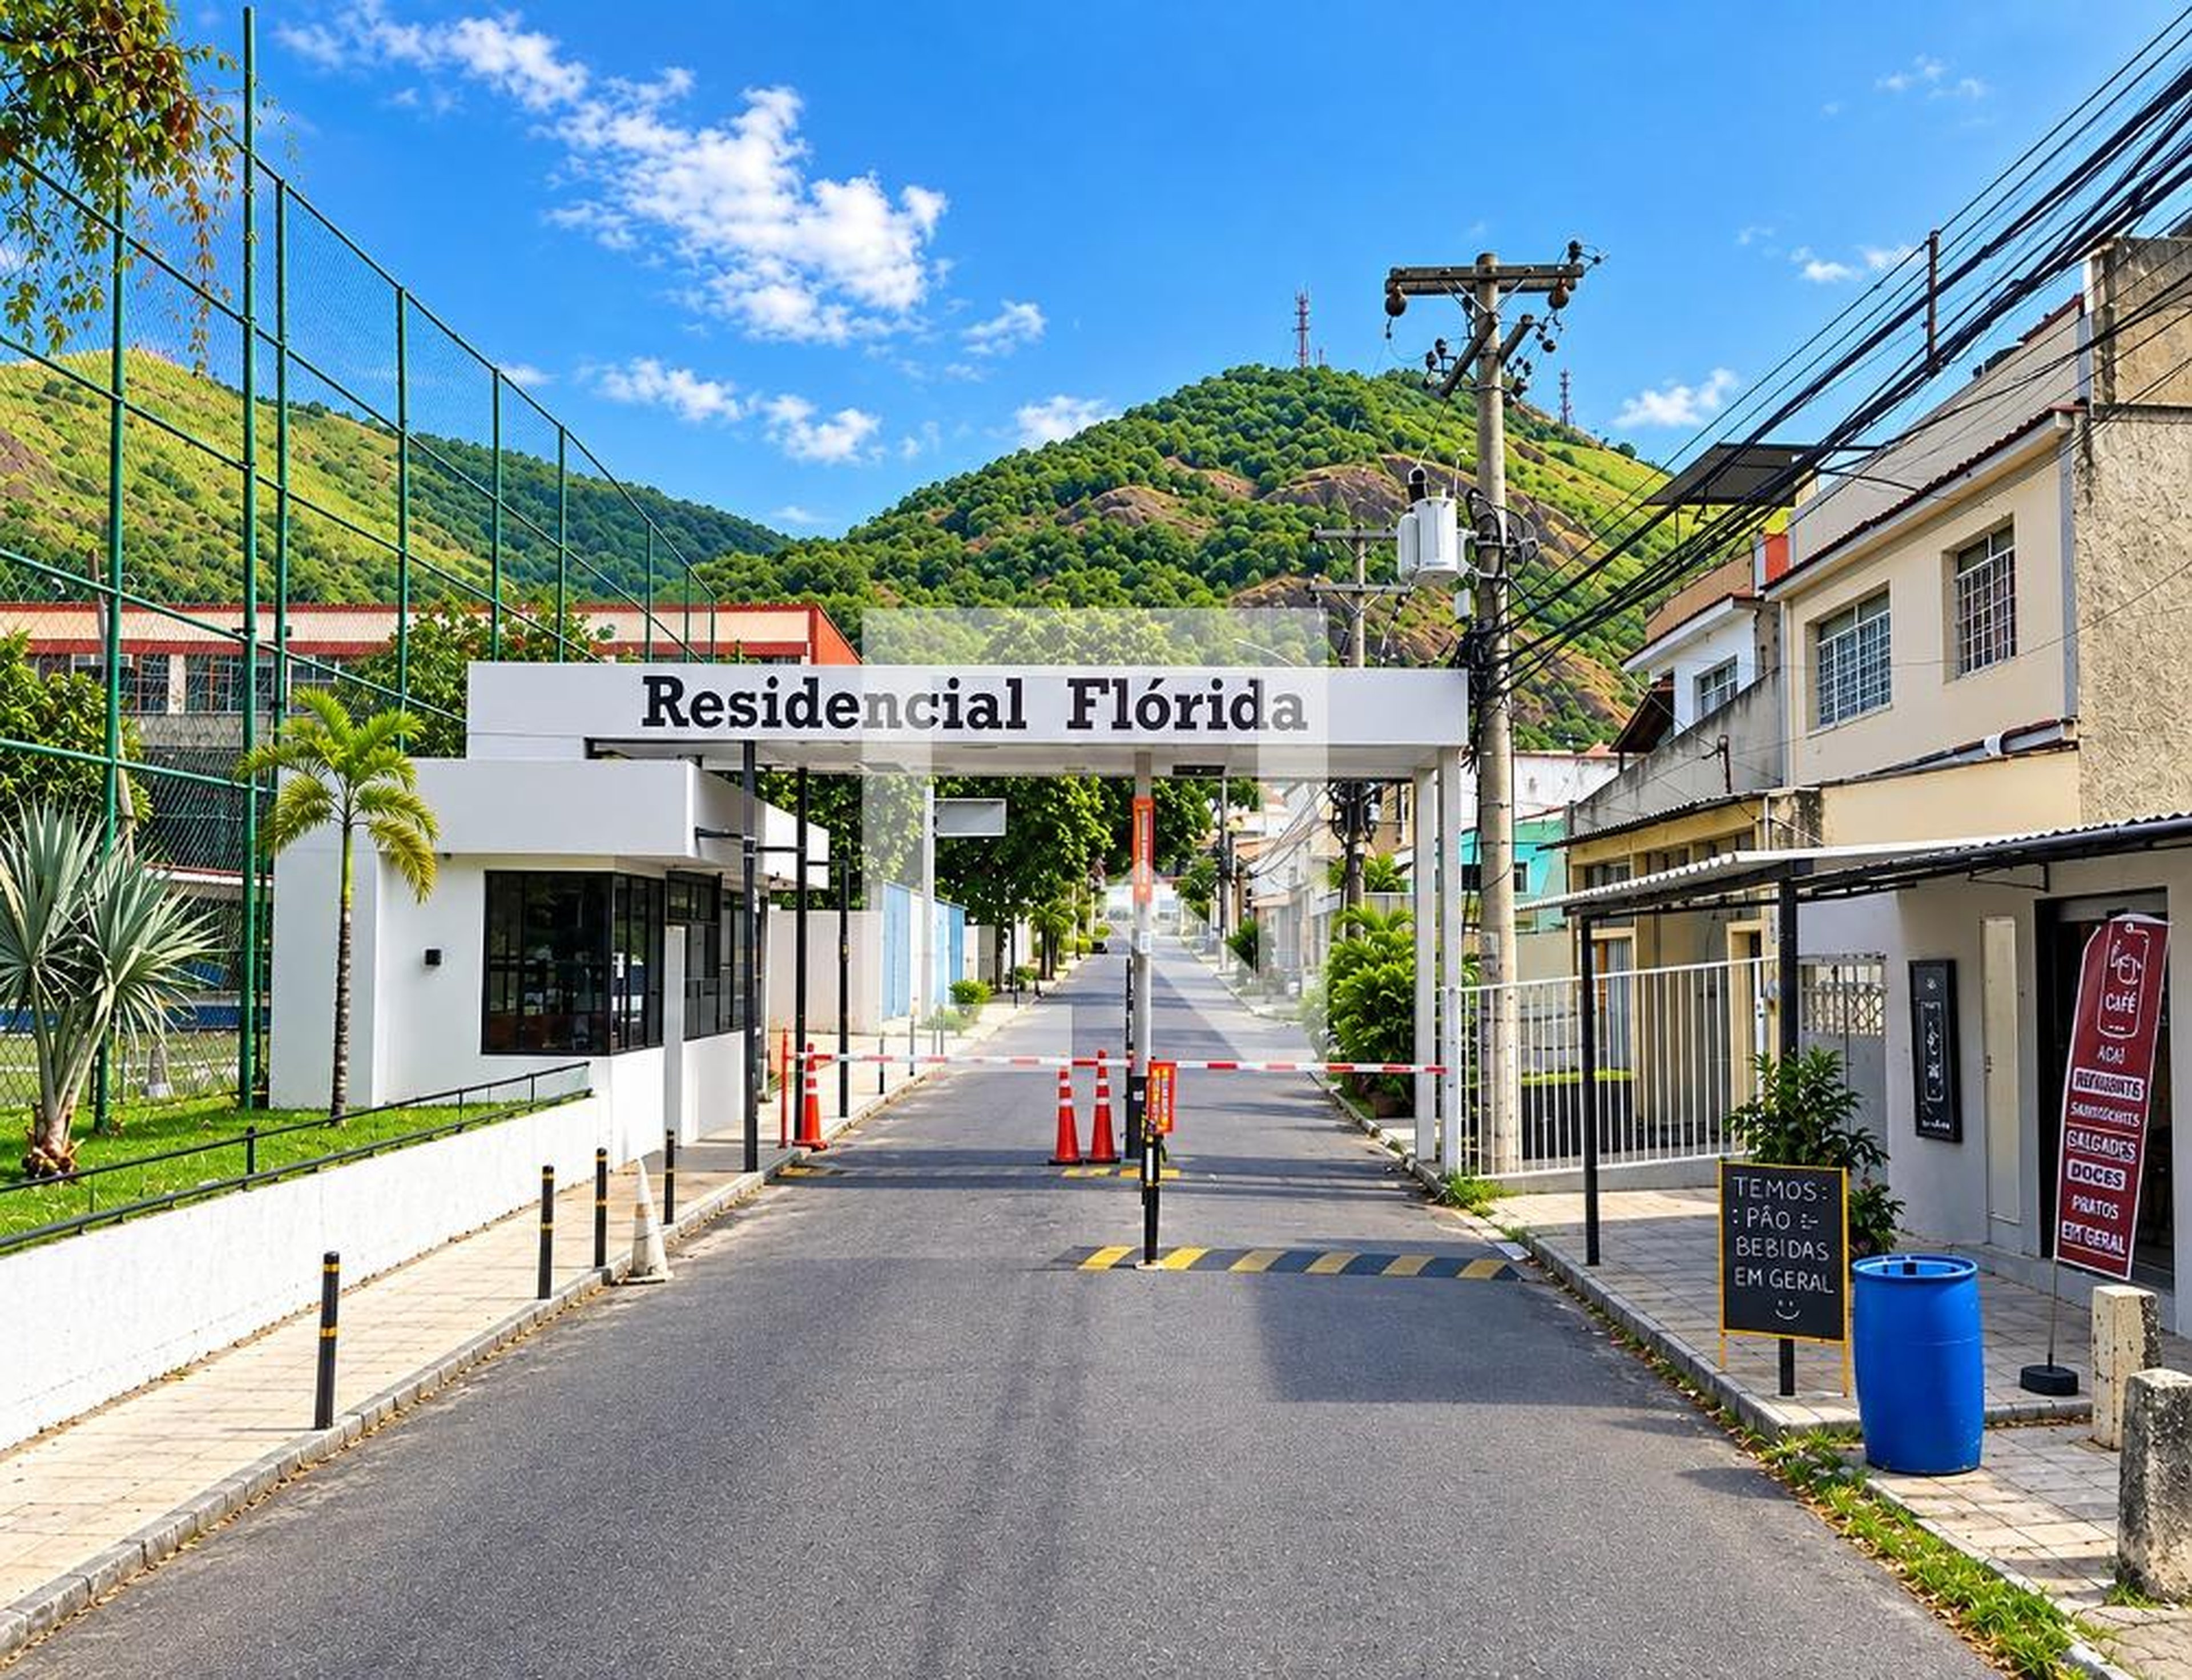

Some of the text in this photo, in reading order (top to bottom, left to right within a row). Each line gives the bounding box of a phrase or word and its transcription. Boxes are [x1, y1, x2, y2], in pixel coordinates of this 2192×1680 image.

[642, 676, 1308, 731] Residencial Flórida
[2071, 1163, 2123, 1187] DOCES
[2071, 1195, 2119, 1220] PRATOS
[1736, 1235, 1830, 1261] BEBIDAS
[2085, 1227, 2125, 1254] GERAL
[1735, 1267, 1835, 1294] EM GERAL
